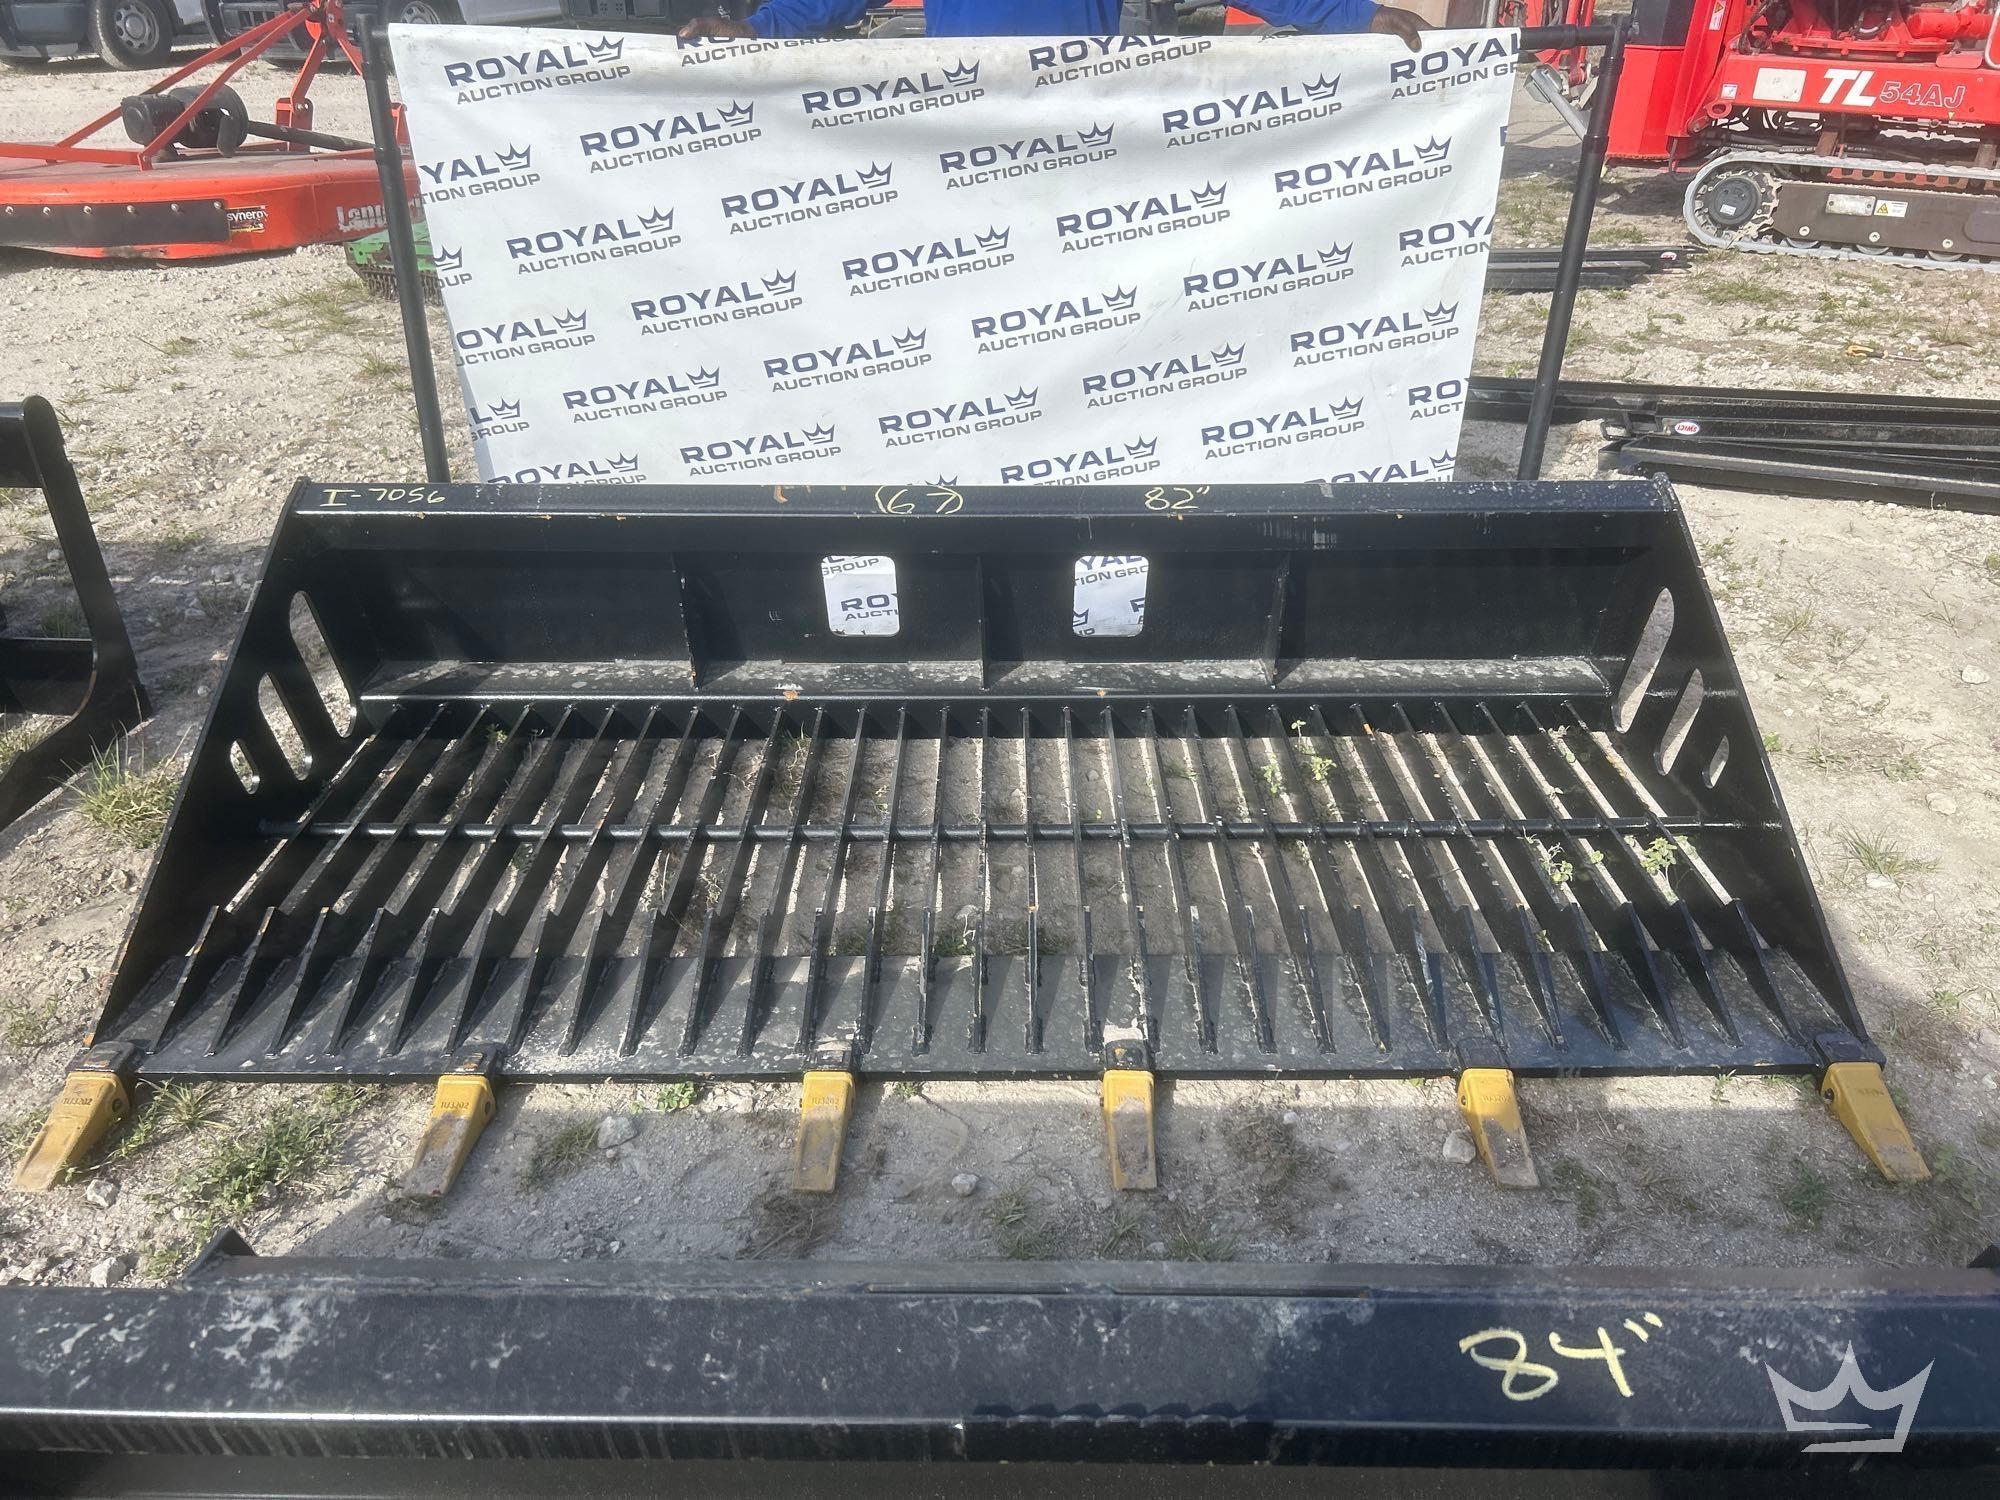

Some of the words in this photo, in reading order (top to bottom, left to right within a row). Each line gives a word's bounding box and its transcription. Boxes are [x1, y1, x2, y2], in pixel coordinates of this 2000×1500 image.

[444, 46, 588, 87] ROYAL
[682, 41, 779, 67] AUCTION
[1035, 58, 1131, 88] AUCTION
[1136, 41, 1211, 67] GROUP
[457, 77, 552, 105] AUCTION
[557, 65, 631, 87] GROUP
[802, 73, 944, 114] ROYAL
[1391, 67, 1488, 100] AUCTION
[1819, 68, 1876, 107] TL
[1880, 81, 1966, 109] 54AJ
[811, 103, 905, 129] AUCTION
[909, 86, 984, 112] GROUP
[1163, 86, 1302, 133] ROYAL
[1167, 120, 1262, 148] AUCTION
[1267, 102, 1342, 128] GROUP
[580, 112, 721, 156] ROYAL
[591, 144, 684, 173] AUCTION
[687, 128, 761, 153] GROUP
[940, 134, 1082, 173] ROYAL
[419, 155, 500, 184] YAL
[468, 173, 540, 195] GROUP
[947, 162, 1039, 190] AUCTION
[1043, 149, 1117, 170] GROUP
[1275, 148, 1414, 193] ROYAL
[1279, 181, 1373, 209] AUCTION
[1378, 165, 1452, 189] GROUP
[721, 174, 859, 218] ROYAL
[730, 206, 822, 234] AUCTION
[825, 190, 898, 214] GROUP
[1056, 193, 1192, 237] ROYAL
[506, 219, 641, 259] ROYAL
[1062, 225, 1153, 253] AUCTION
[1158, 210, 1230, 233] GROUP
[519, 249, 607, 275] AUCTION
[610, 235, 681, 258] GROUP
[842, 238, 976, 280] ROYAL
[850, 268, 939, 296] AUCTION
[944, 254, 1014, 277] GROUP
[1183, 254, 1317, 296] ROYAL
[631, 282, 764, 320] ROYAL
[1188, 284, 1278, 312] AUCTION
[1283, 268, 1353, 292] GROUP
[456, 318, 557, 349] OYAL
[642, 312, 728, 335] AUCTION
[732, 297, 802, 320] GROUP
[971, 297, 1103, 338] ROYAL
[978, 327, 1066, 354] AUCTION
[1070, 313, 1141, 335] GROUP
[1290, 312, 1422, 352] ROYAL
[528, 335, 595, 354] GROUP
[763, 339, 894, 378] ROYAL
[1294, 341, 1383, 367] AUCTION
[1388, 327, 1459, 349] GROUP
[563, 376, 688, 409] ROYAL
[773, 368, 859, 392] AUCTION
[863, 354, 931, 376] GROUP
[1083, 354, 1211, 395] ROYAL
[1087, 382, 1174, 408] AUCTION
[1178, 368, 1247, 390] GROUP
[1408, 378, 1468, 406] RO
[574, 402, 657, 423] AUCTION
[660, 391, 727, 409] GROUP
[878, 397, 1006, 434] ROYAL
[1201, 407, 1329, 445] ROYAL
[1410, 401, 1463, 420] AUCT
[680, 432, 804, 464] ROYAL
[886, 425, 970, 448] AUCTION
[975, 410, 1042, 432] GROUP
[1205, 435, 1291, 460] AUCTION
[1296, 421, 1364, 442] GROUP
[690, 457, 772, 476] AUCTION
[775, 447, 841, 464] GROUP
[1001, 447, 1125, 484] ROYAL
[1094, 460, 1160, 481] GROUP
